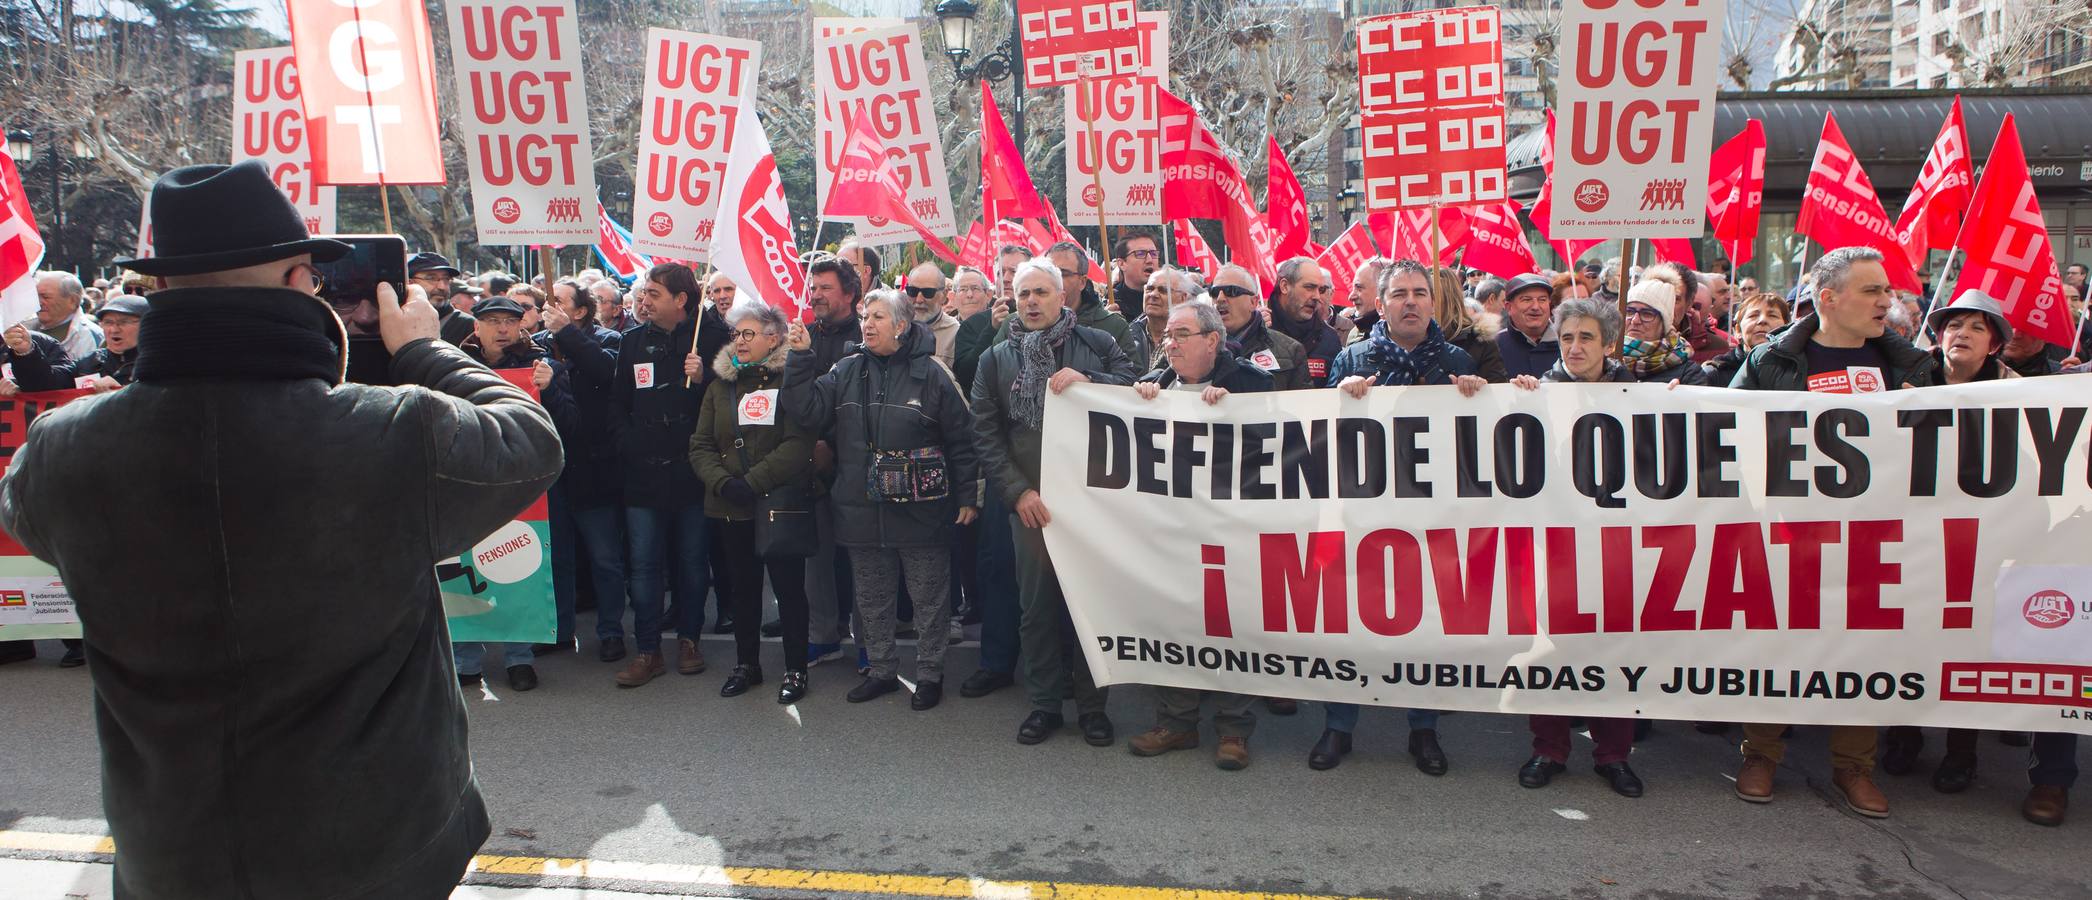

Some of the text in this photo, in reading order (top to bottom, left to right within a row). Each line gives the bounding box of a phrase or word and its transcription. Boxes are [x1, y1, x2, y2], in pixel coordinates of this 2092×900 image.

[461, 6, 564, 61] UGT
[1576, 20, 1708, 88] UGT
[245, 56, 301, 104] UG
[329, 0, 404, 173] GT
[658, 39, 749, 97] UGT
[828, 34, 910, 91] UGT
[470, 71, 571, 124] UGT
[1076, 76, 1158, 122] UGT
[244, 109, 302, 156] UG
[653, 97, 738, 153] UGT
[1571, 99, 1700, 165] UGT
[478, 134, 578, 186] UGT
[1076, 129, 1160, 175] UGT
[1582, 184, 1602, 194] UGT
[1086, 407, 2092, 508] DEFIENDE LO QUE ES TUY
[478, 533, 532, 566] PENSIONES
[1259, 518, 1904, 636] MOVILIZATE
[2028, 596, 2069, 612] UGT
[1098, 636, 1925, 701] PENSIONISTAS, JUBILADAS Y JUBILIADOS
[1949, 670, 2074, 698] CCOO
[2061, 709, 2079, 720] LA
